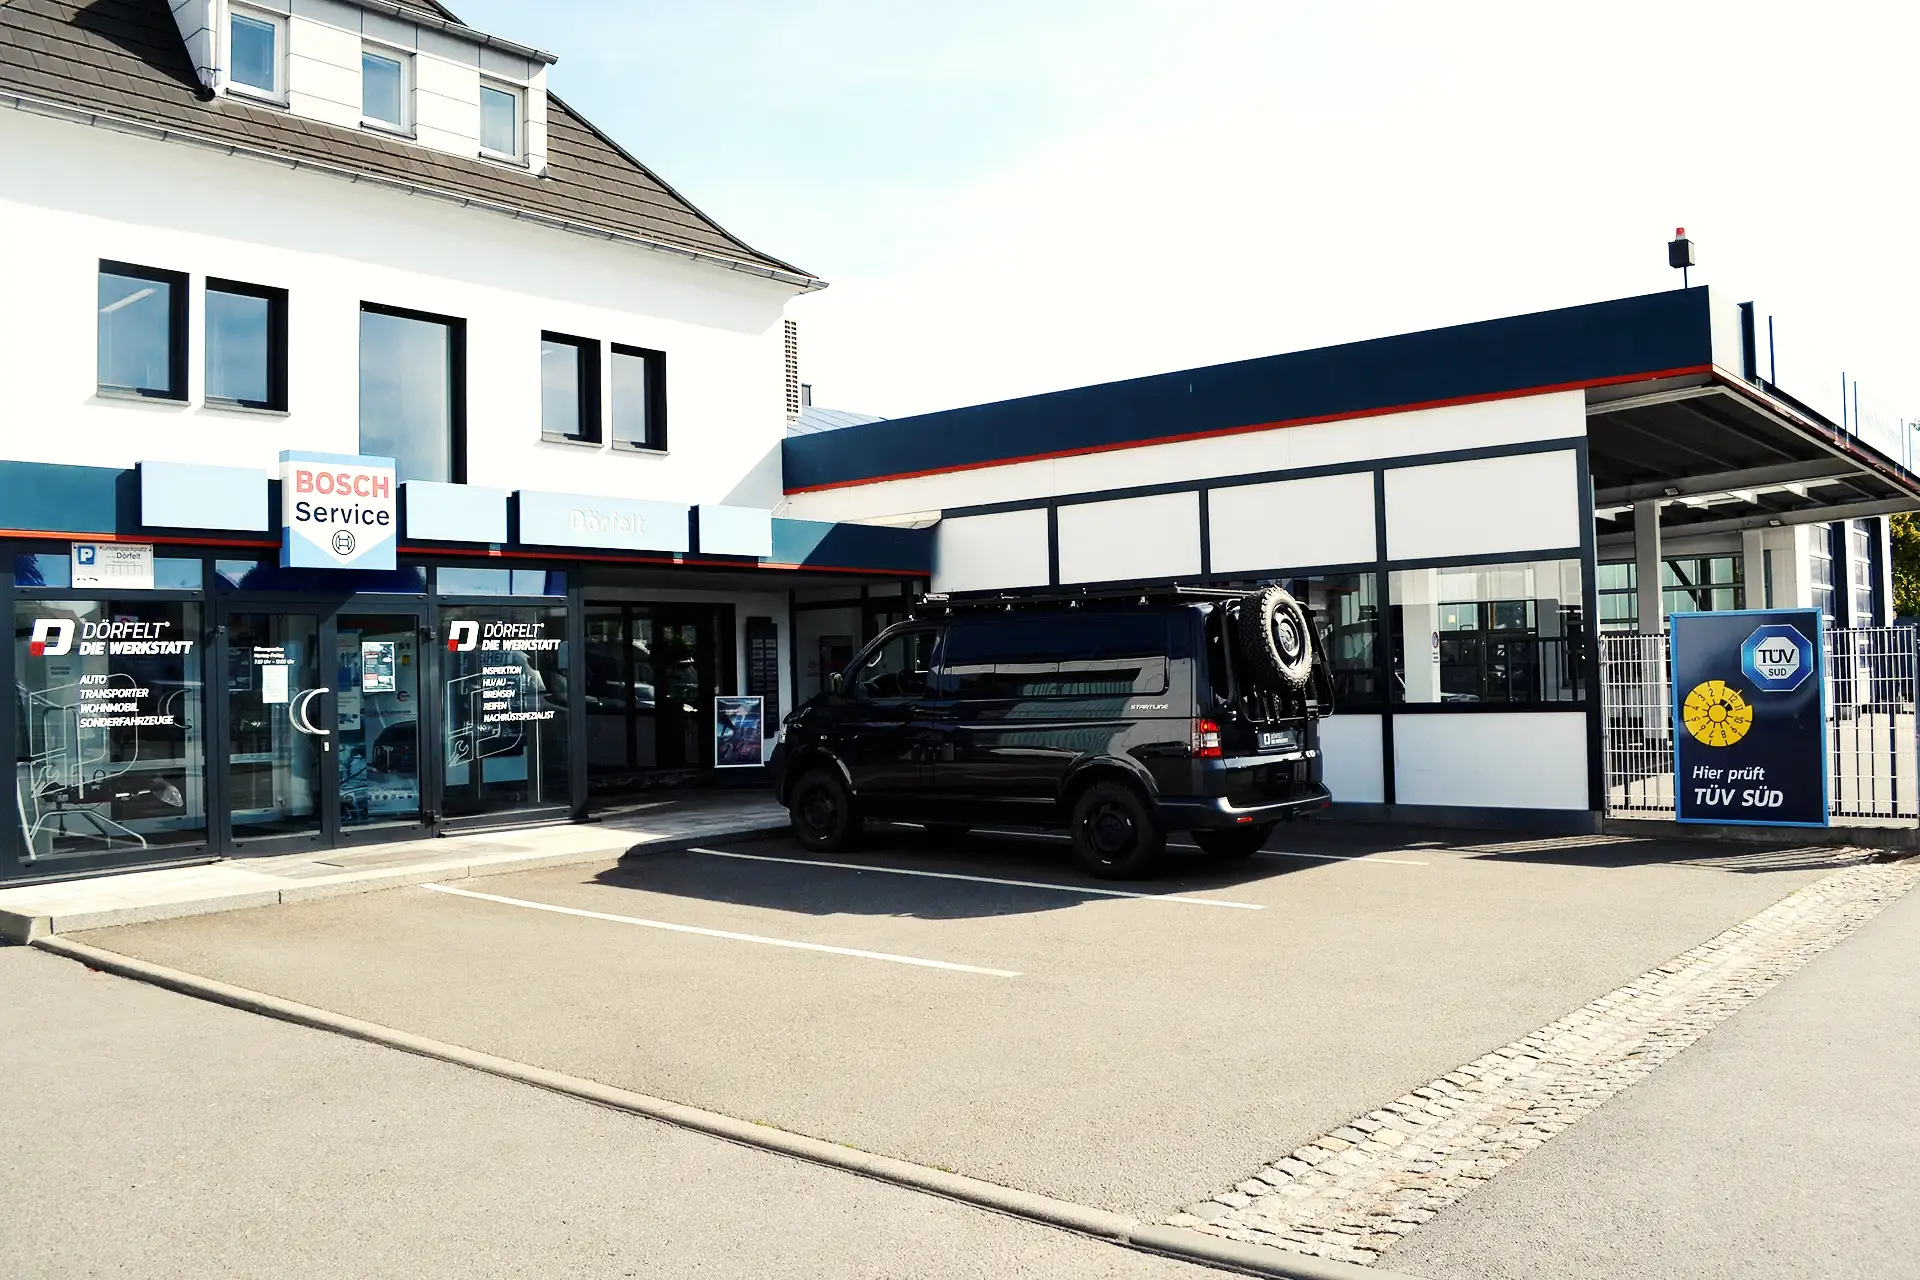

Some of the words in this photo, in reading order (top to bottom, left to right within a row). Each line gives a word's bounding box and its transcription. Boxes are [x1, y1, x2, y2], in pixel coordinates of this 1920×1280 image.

[296, 469, 389, 499] BOSCH
[295, 501, 390, 526] Service
[570, 509, 645, 535] Dörfelt
[80, 548, 94, 562] P
[116, 552, 141, 560] Dörfelt
[79, 641, 105, 656] DIE
[109, 640, 194, 655] WERKSTATT
[481, 639, 500, 651] DIE
[502, 639, 561, 651] WERKSTATT
[1758, 649, 1795, 663] TÜV
[482, 666, 522, 675] INSPEKTION
[79, 675, 107, 684] AUTO
[482, 678, 506, 687] HU/AU
[80, 689, 149, 699] TRANSPORTER
[482, 690, 515, 699] BREMSEN
[80, 703, 139, 714] WOHNMOBIL
[483, 702, 507, 711] REIFEN
[80, 715, 175, 728] SONDERFAHRZEUGE
[484, 711, 555, 723] NACHRÜSTSPEZIALIST
[1693, 765, 1723, 780] Hier
[1728, 766, 1765, 783] prüft
[1694, 784, 1736, 806] TÜV
[1742, 785, 1784, 808] SÜD
